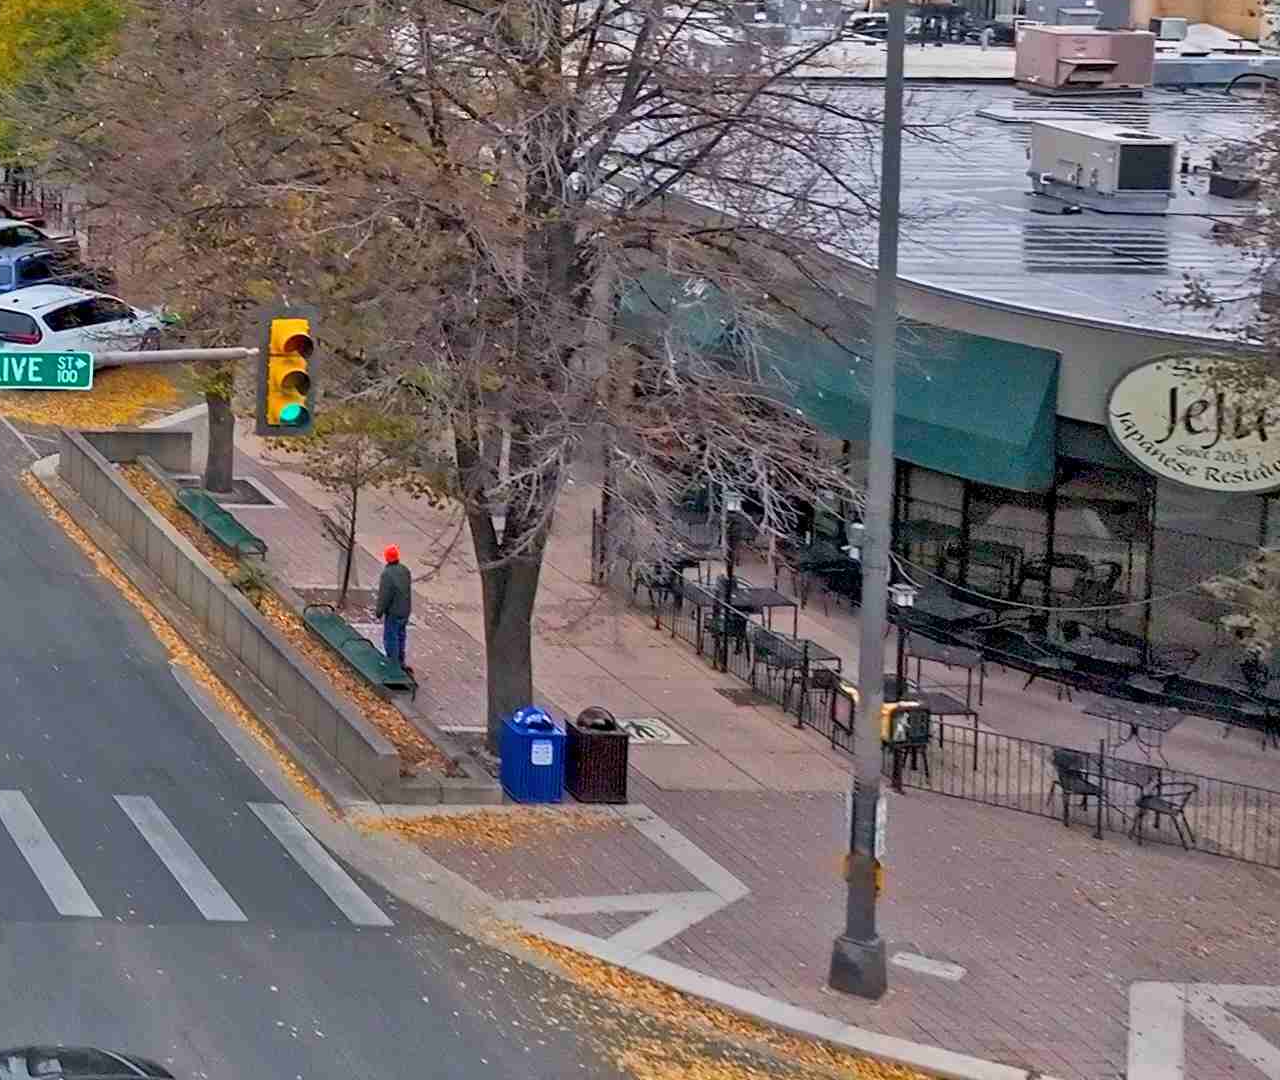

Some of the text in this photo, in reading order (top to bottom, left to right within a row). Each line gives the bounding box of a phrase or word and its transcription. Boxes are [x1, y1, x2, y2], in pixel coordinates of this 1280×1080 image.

[57, 356, 74, 370] ST
[57, 370, 78, 383] 100
[1111, 411, 1198, 476] Japanese
